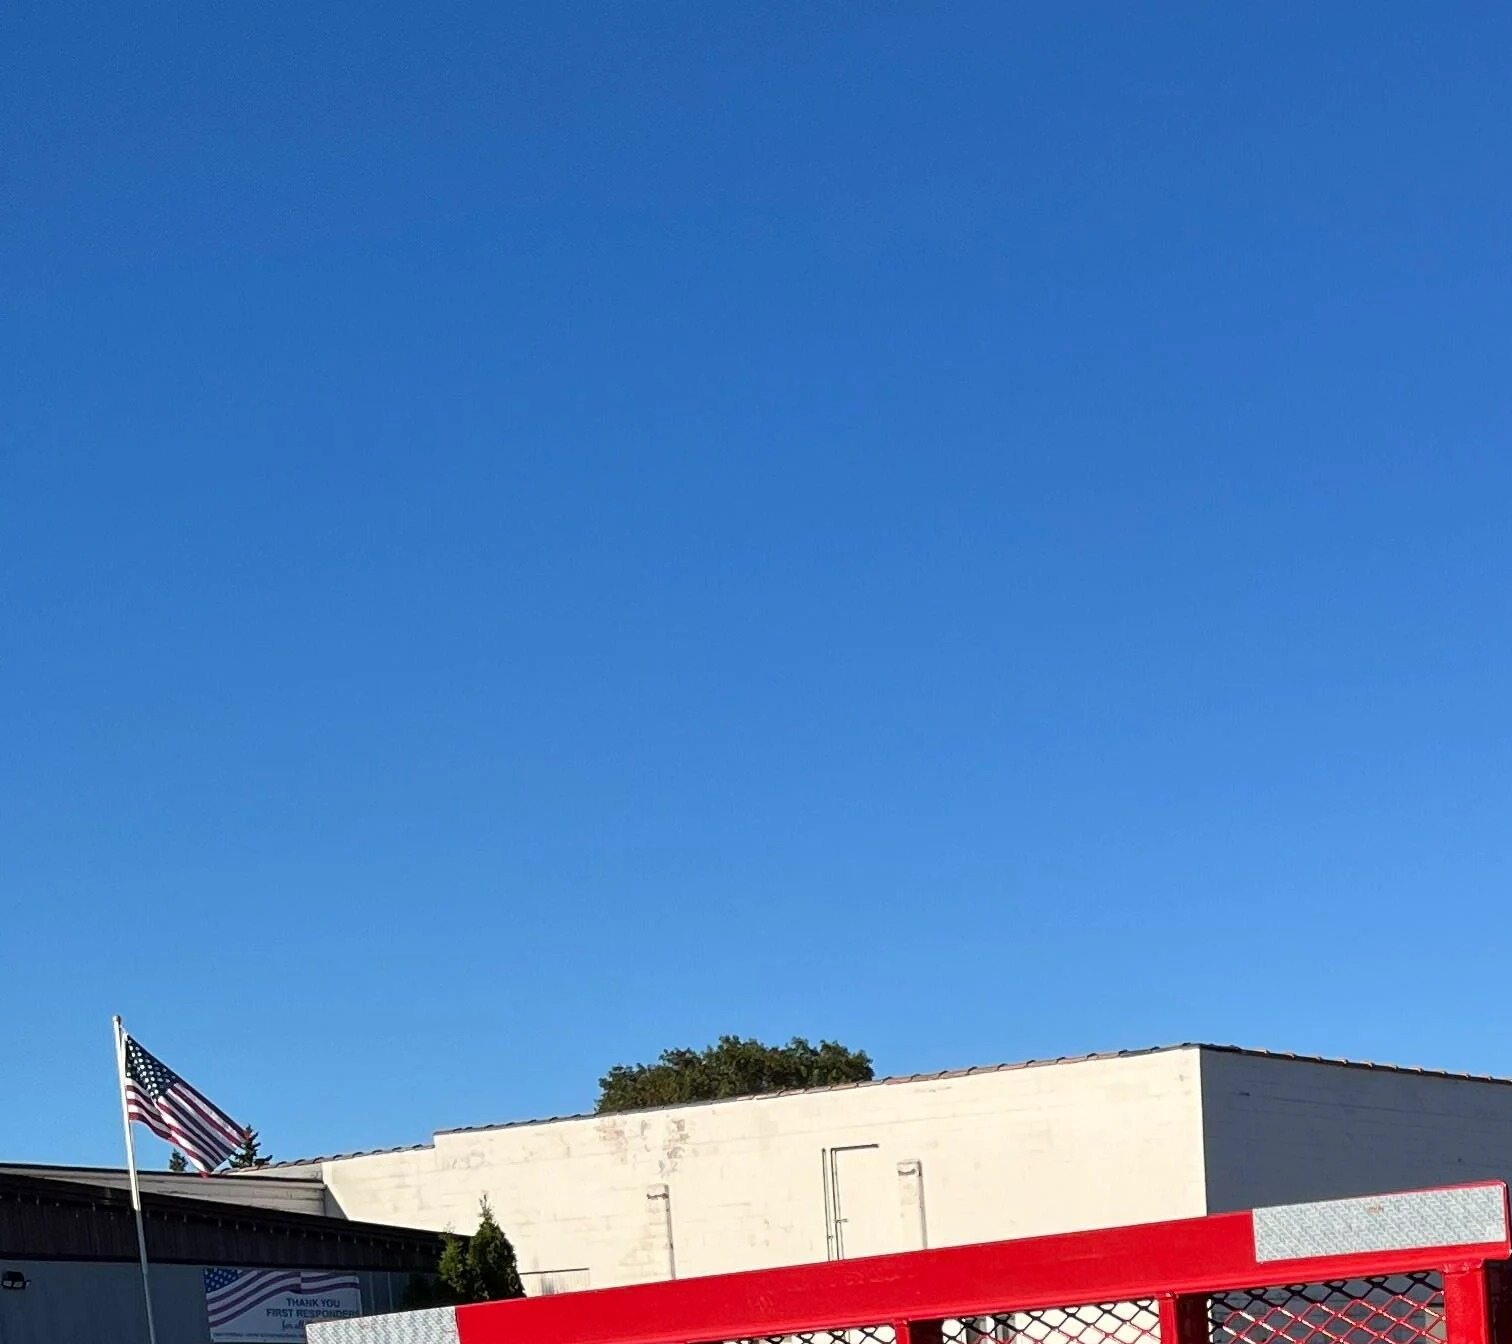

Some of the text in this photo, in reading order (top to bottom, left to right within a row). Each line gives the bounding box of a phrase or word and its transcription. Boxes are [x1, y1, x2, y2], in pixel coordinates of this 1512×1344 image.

[286, 1298, 341, 1309] THANK YOU
[266, 1308, 293, 1318] FIRST
